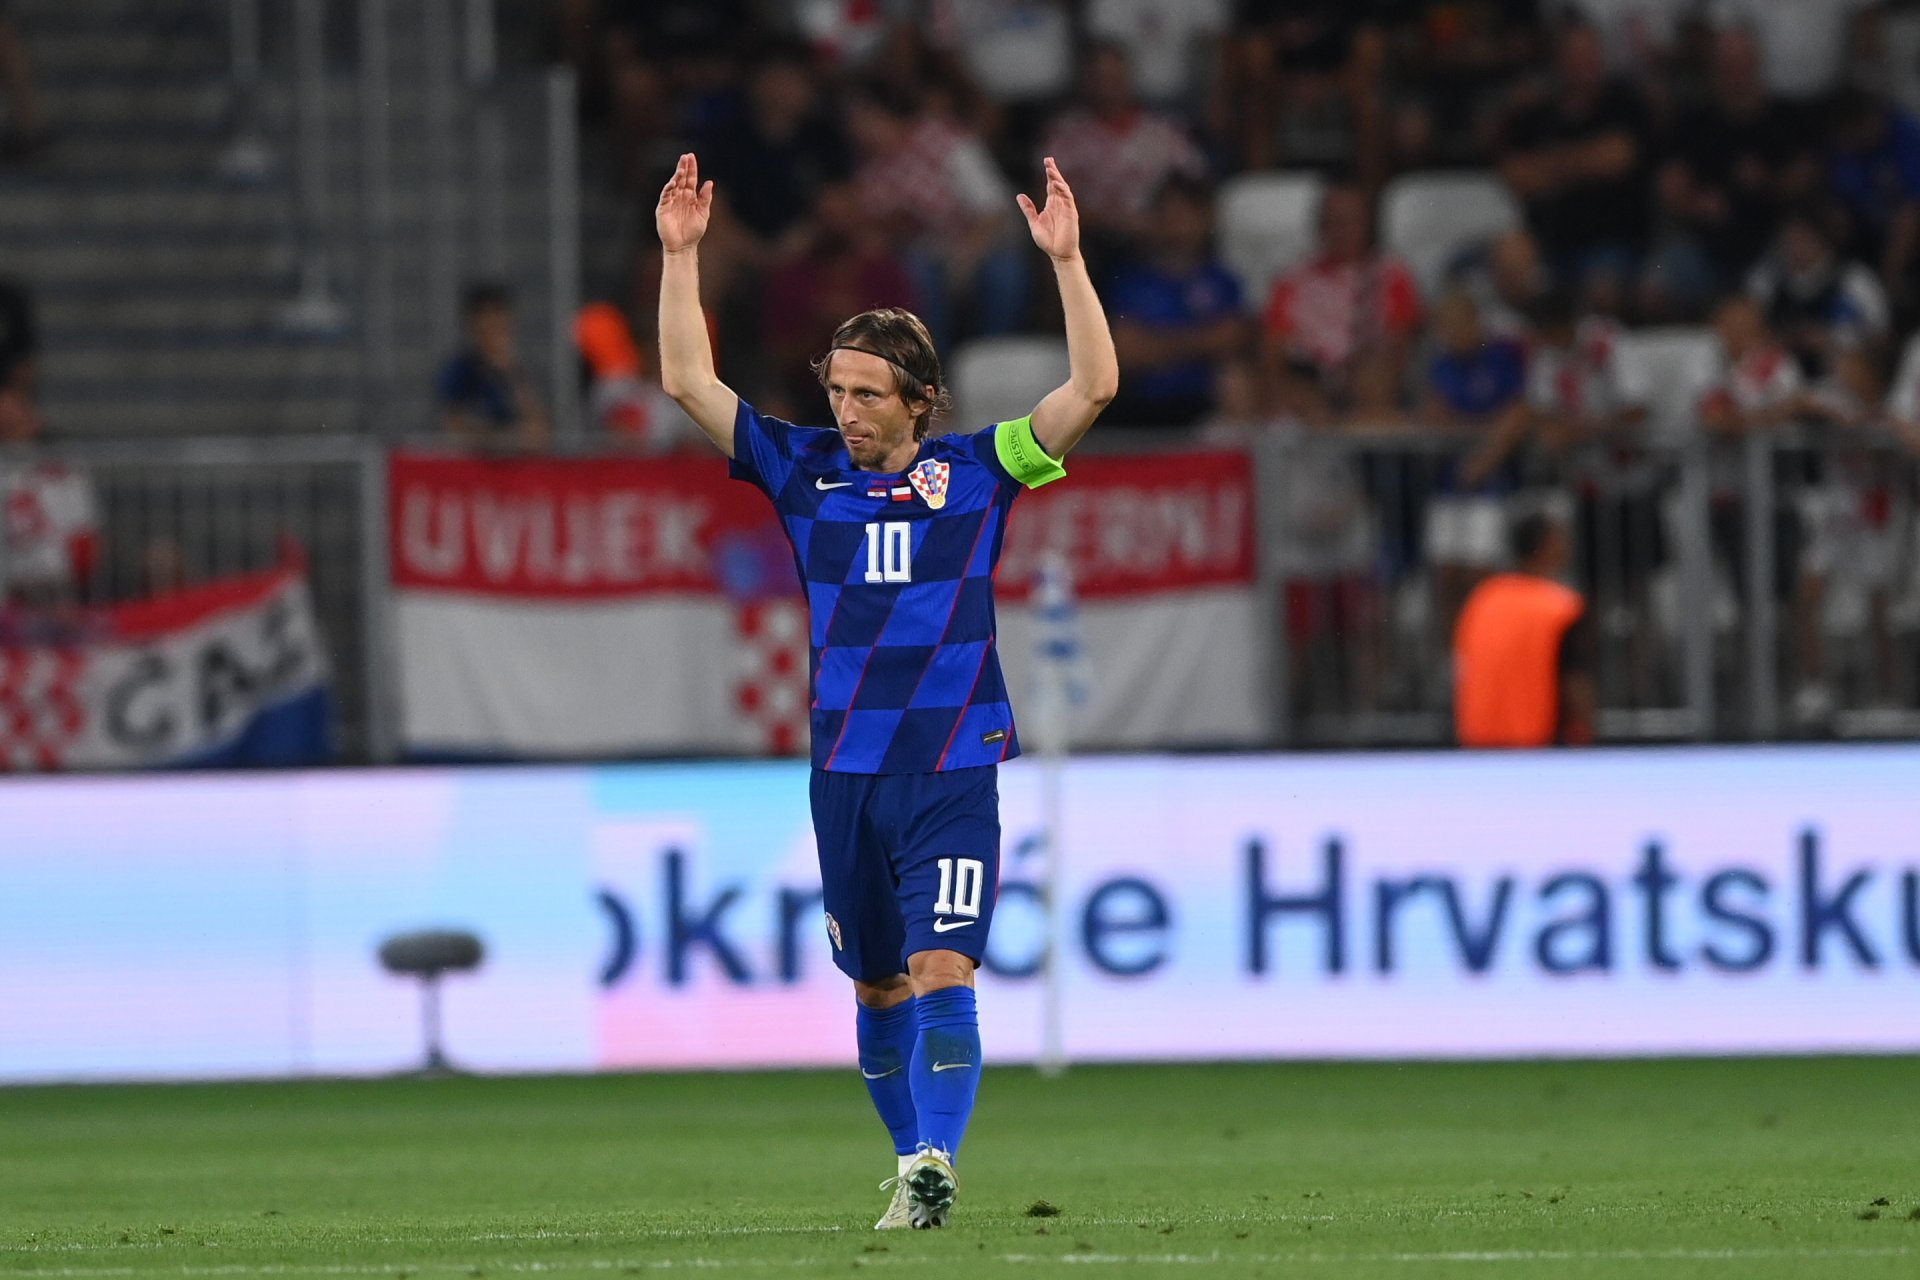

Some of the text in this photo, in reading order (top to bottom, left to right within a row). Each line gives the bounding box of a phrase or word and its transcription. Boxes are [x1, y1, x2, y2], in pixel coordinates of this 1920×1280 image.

[404, 483, 1242, 584] UVIJEK JERNI
[865, 522, 911, 583] 10
[933, 858, 983, 918] 10
